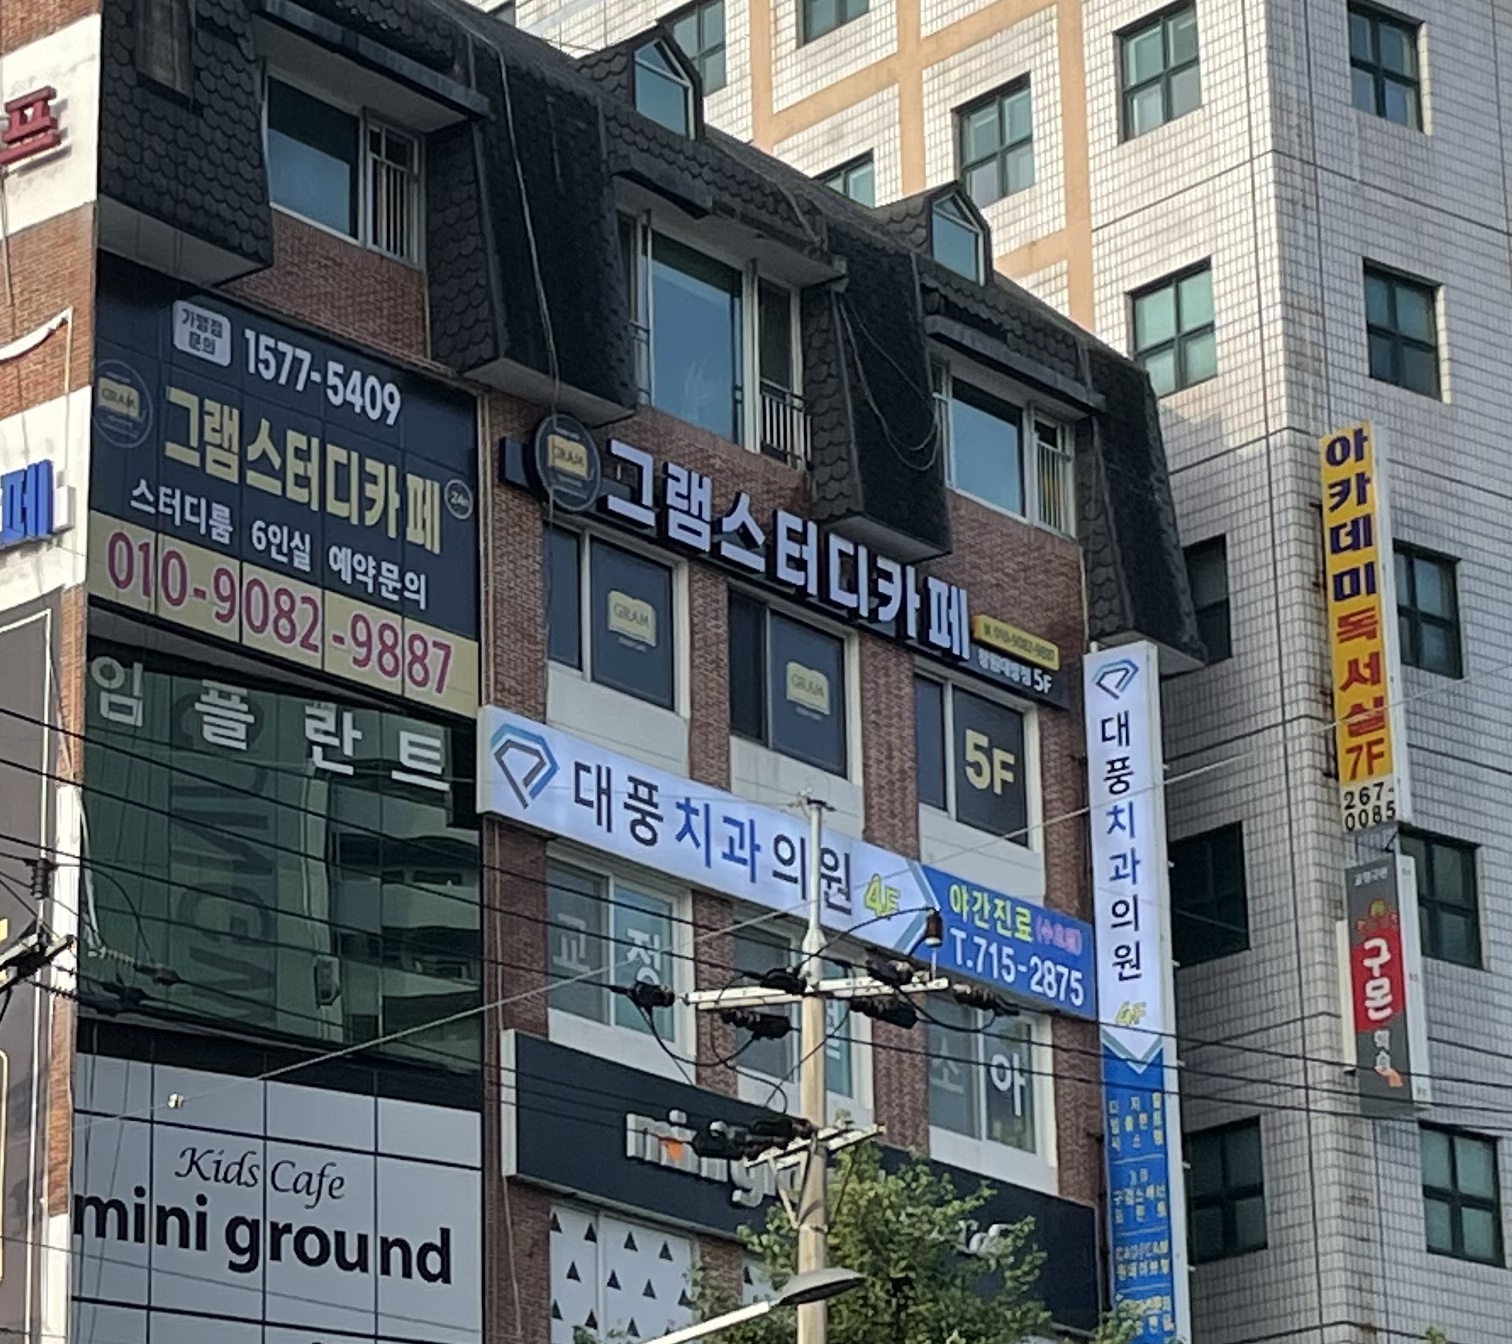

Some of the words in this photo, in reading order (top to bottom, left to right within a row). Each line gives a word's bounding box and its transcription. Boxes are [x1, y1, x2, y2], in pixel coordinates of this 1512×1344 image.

[189, 331, 216, 356] 문의
[244, 328, 403, 426] 1577-5409
[164, 385, 441, 555] 그램스터디카페
[1325, 426, 1378, 598] 아카데미
[129, 478, 234, 545] 스터디룸
[251, 519, 312, 572] 6인실
[329, 543, 428, 611] 예약문의
[607, 438, 971, 662] 그램스터디카페
[107, 530, 454, 695] 010-9082-9887
[1033, 667, 1053, 694] 5F
[1336, 606, 1386, 737] 독서실
[91, 655, 451, 791] 임플란트
[964, 728, 1016, 796] 5F
[1345, 739, 1386, 782] 7F
[573, 760, 854, 917] 대풍치과의원
[1100, 711, 1143, 983] 대풍치과의원
[1344, 802, 1397, 832] 0085
[949, 883, 1034, 944] 야간진료
[949, 927, 1085, 1007] T.715-2875
[1362, 937, 1393, 1022] 구몬
[174, 1147, 260, 1188] Kids
[270, 1160, 345, 1209] Cafe
[73, 1186, 208, 1252] mini
[225, 1215, 453, 1285] ground
